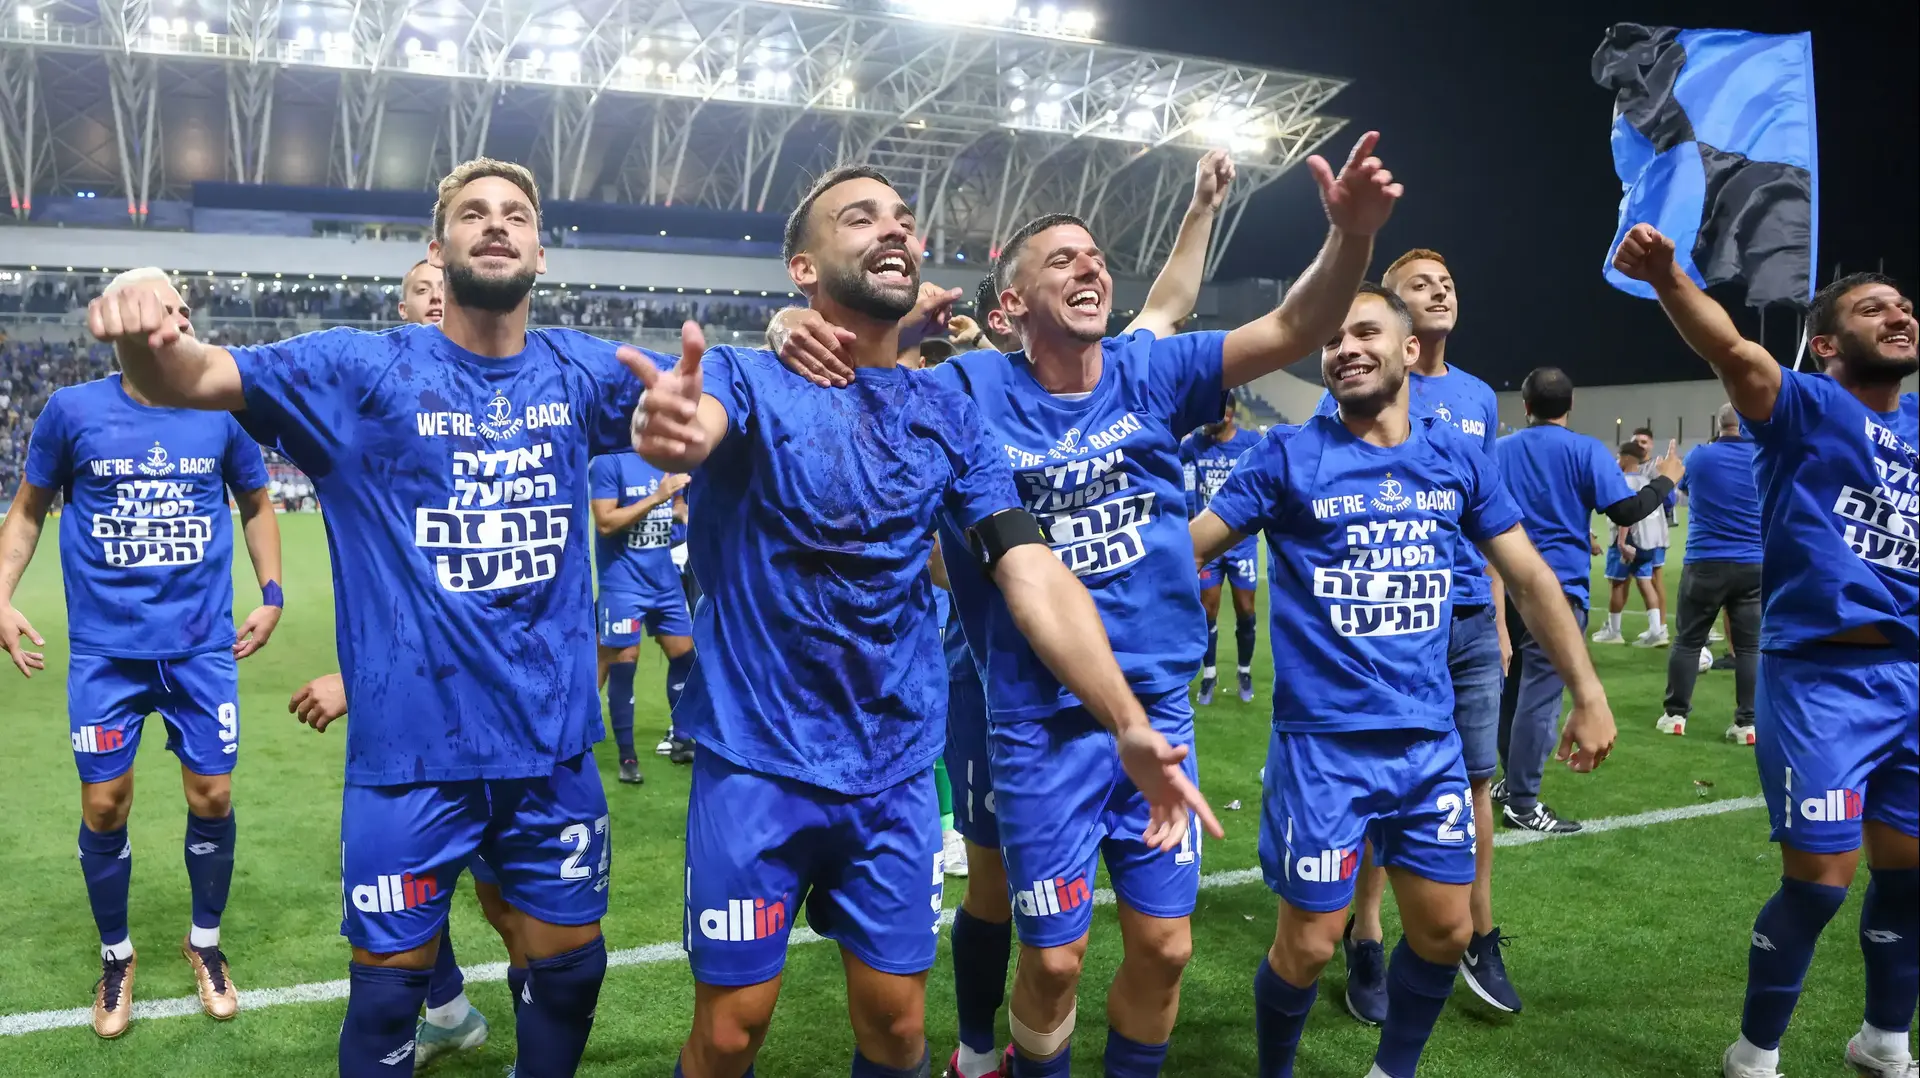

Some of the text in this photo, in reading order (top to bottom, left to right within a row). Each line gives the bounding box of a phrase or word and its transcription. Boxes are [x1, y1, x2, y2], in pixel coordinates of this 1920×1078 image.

[416, 411, 477, 437] WE'RE
[1088, 413, 1142, 450] BACK!
[91, 457, 216, 477] WE'RE BACK!
[452, 442, 553, 477] יאללה
[116, 479, 194, 500] יאללה
[448, 473, 557, 511] הפועל,
[1312, 490, 1456, 520] WE'RE BACK!
[111, 497, 195, 518] הפועל,
[1843, 490, 1896, 529] זה
[99, 517, 208, 539] הנה זה
[427, 508, 571, 544] הנה זה
[1346, 519, 1437, 545] יאללה
[112, 541, 198, 566] הגיע!
[449, 544, 565, 590] הגיע!
[1341, 544, 1435, 571] הפועל,
[1322, 570, 1447, 599] הנה זה
[1340, 603, 1435, 636] הגיע!
[72, 725, 124, 753] allin
[217, 702, 237, 743] 9
[1801, 787, 1864, 822] allin
[559, 813, 610, 881] 27
[352, 871, 437, 913] allin
[1015, 876, 1091, 917] allin
[700, 897, 786, 942] allin
